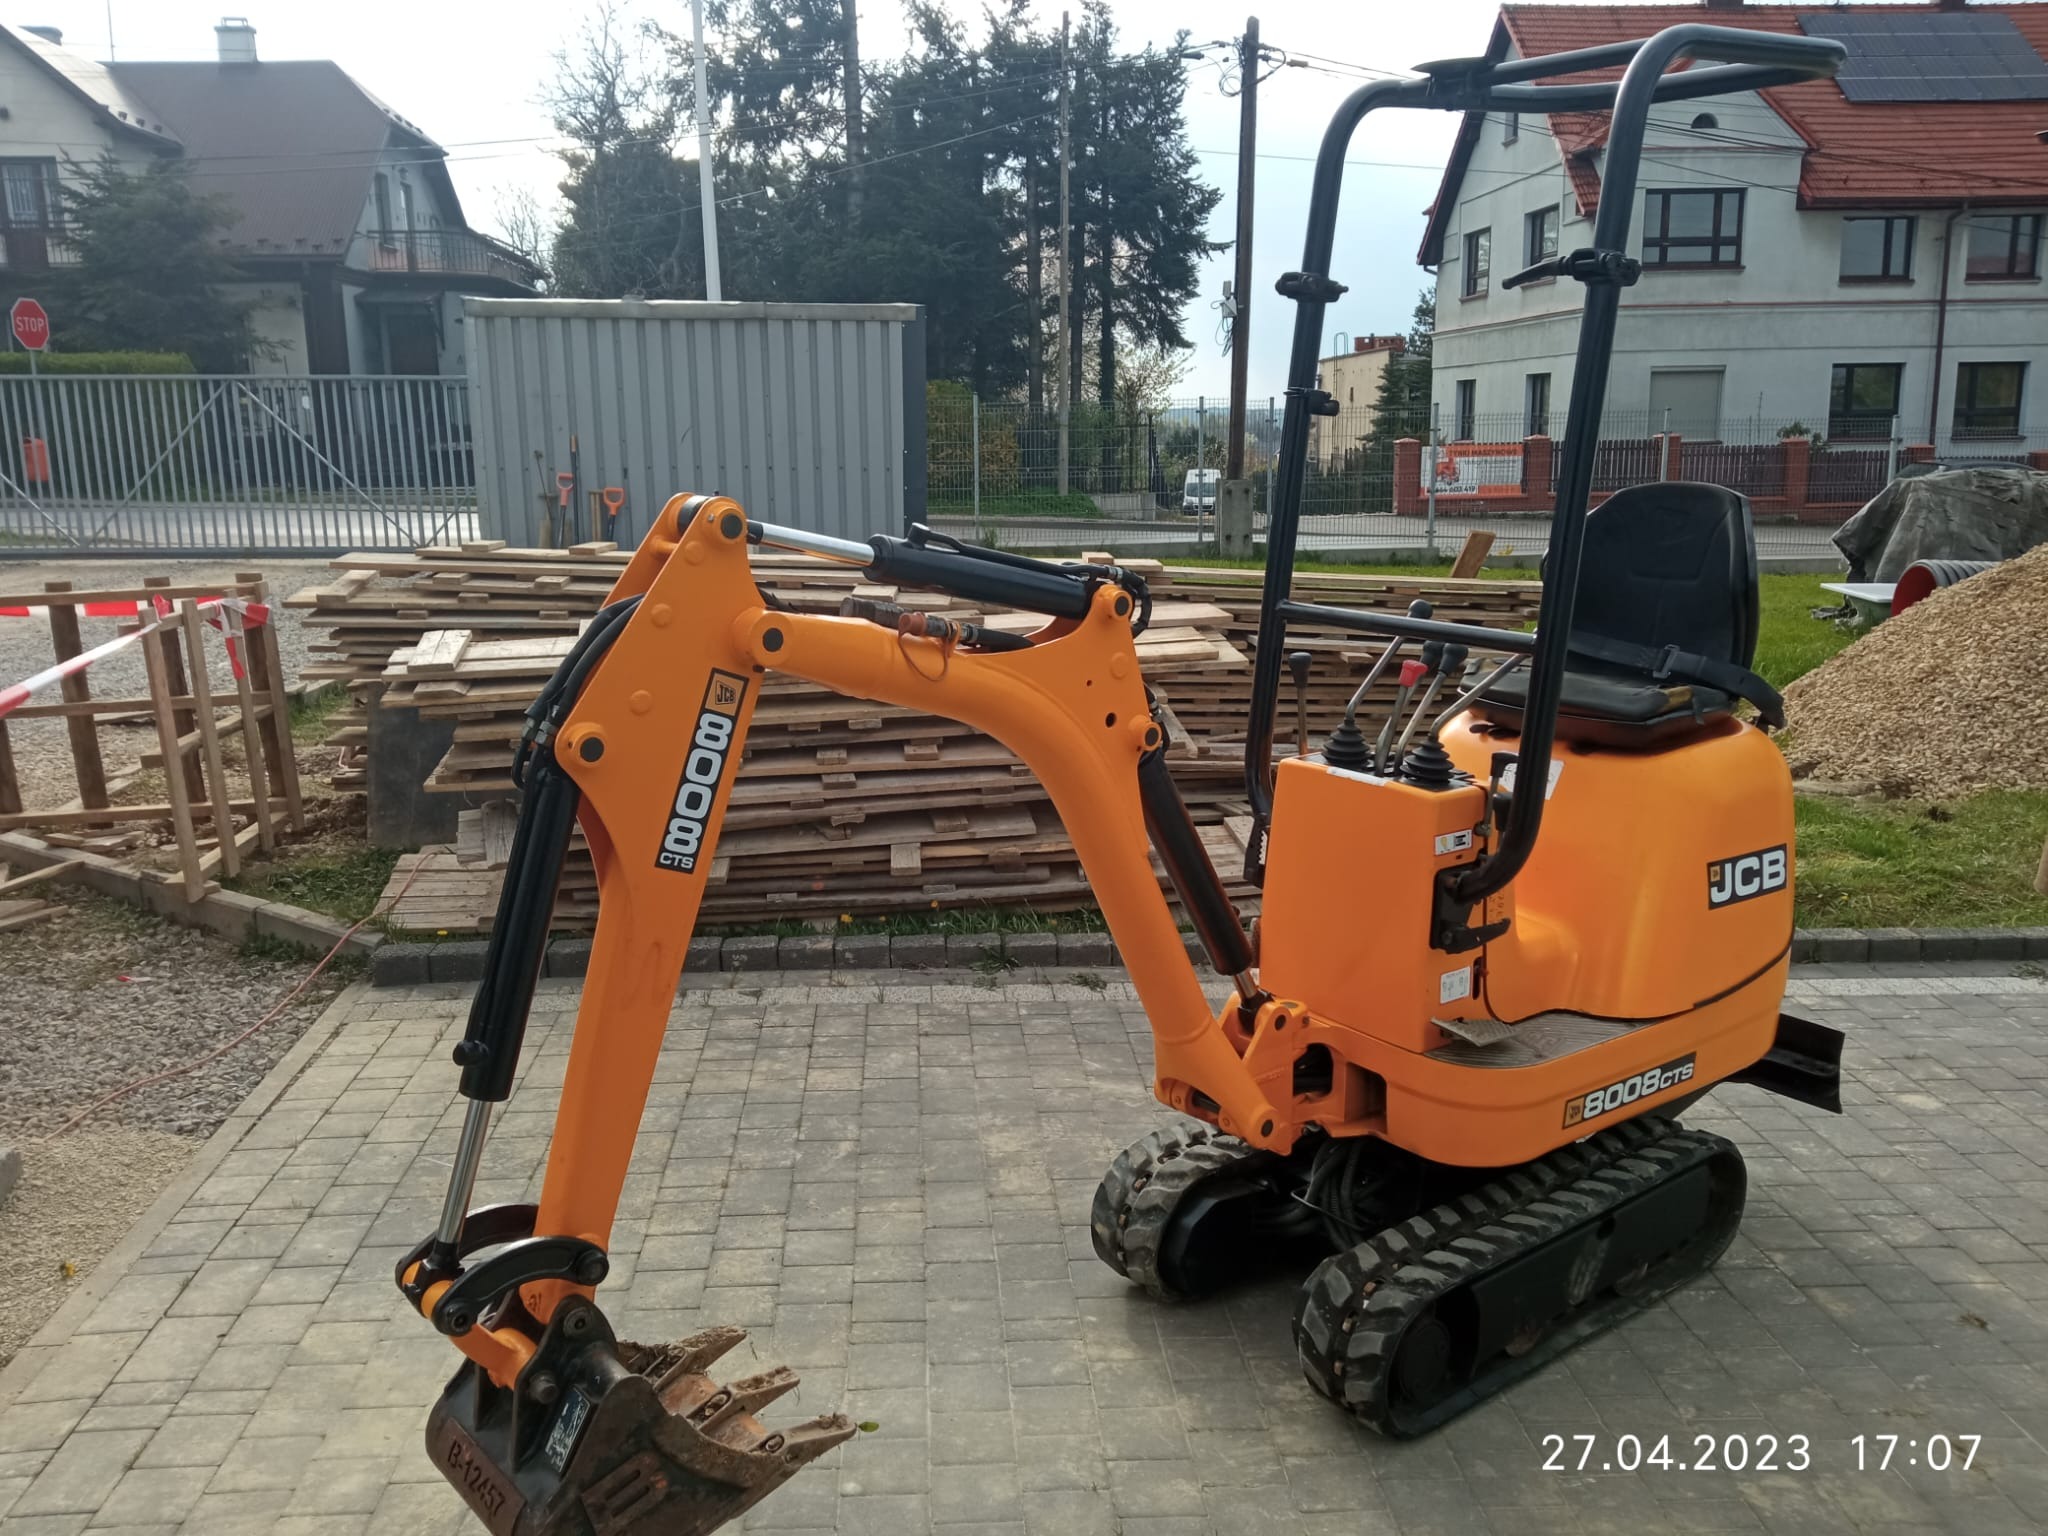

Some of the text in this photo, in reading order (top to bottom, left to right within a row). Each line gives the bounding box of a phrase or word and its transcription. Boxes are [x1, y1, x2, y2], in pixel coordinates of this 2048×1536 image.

[16, 316, 45, 332] STOP
[717, 684, 736, 703] JCB
[664, 713, 733, 855] 8008
[659, 852, 694, 869] CTS
[1711, 850, 1785, 903] JCB
